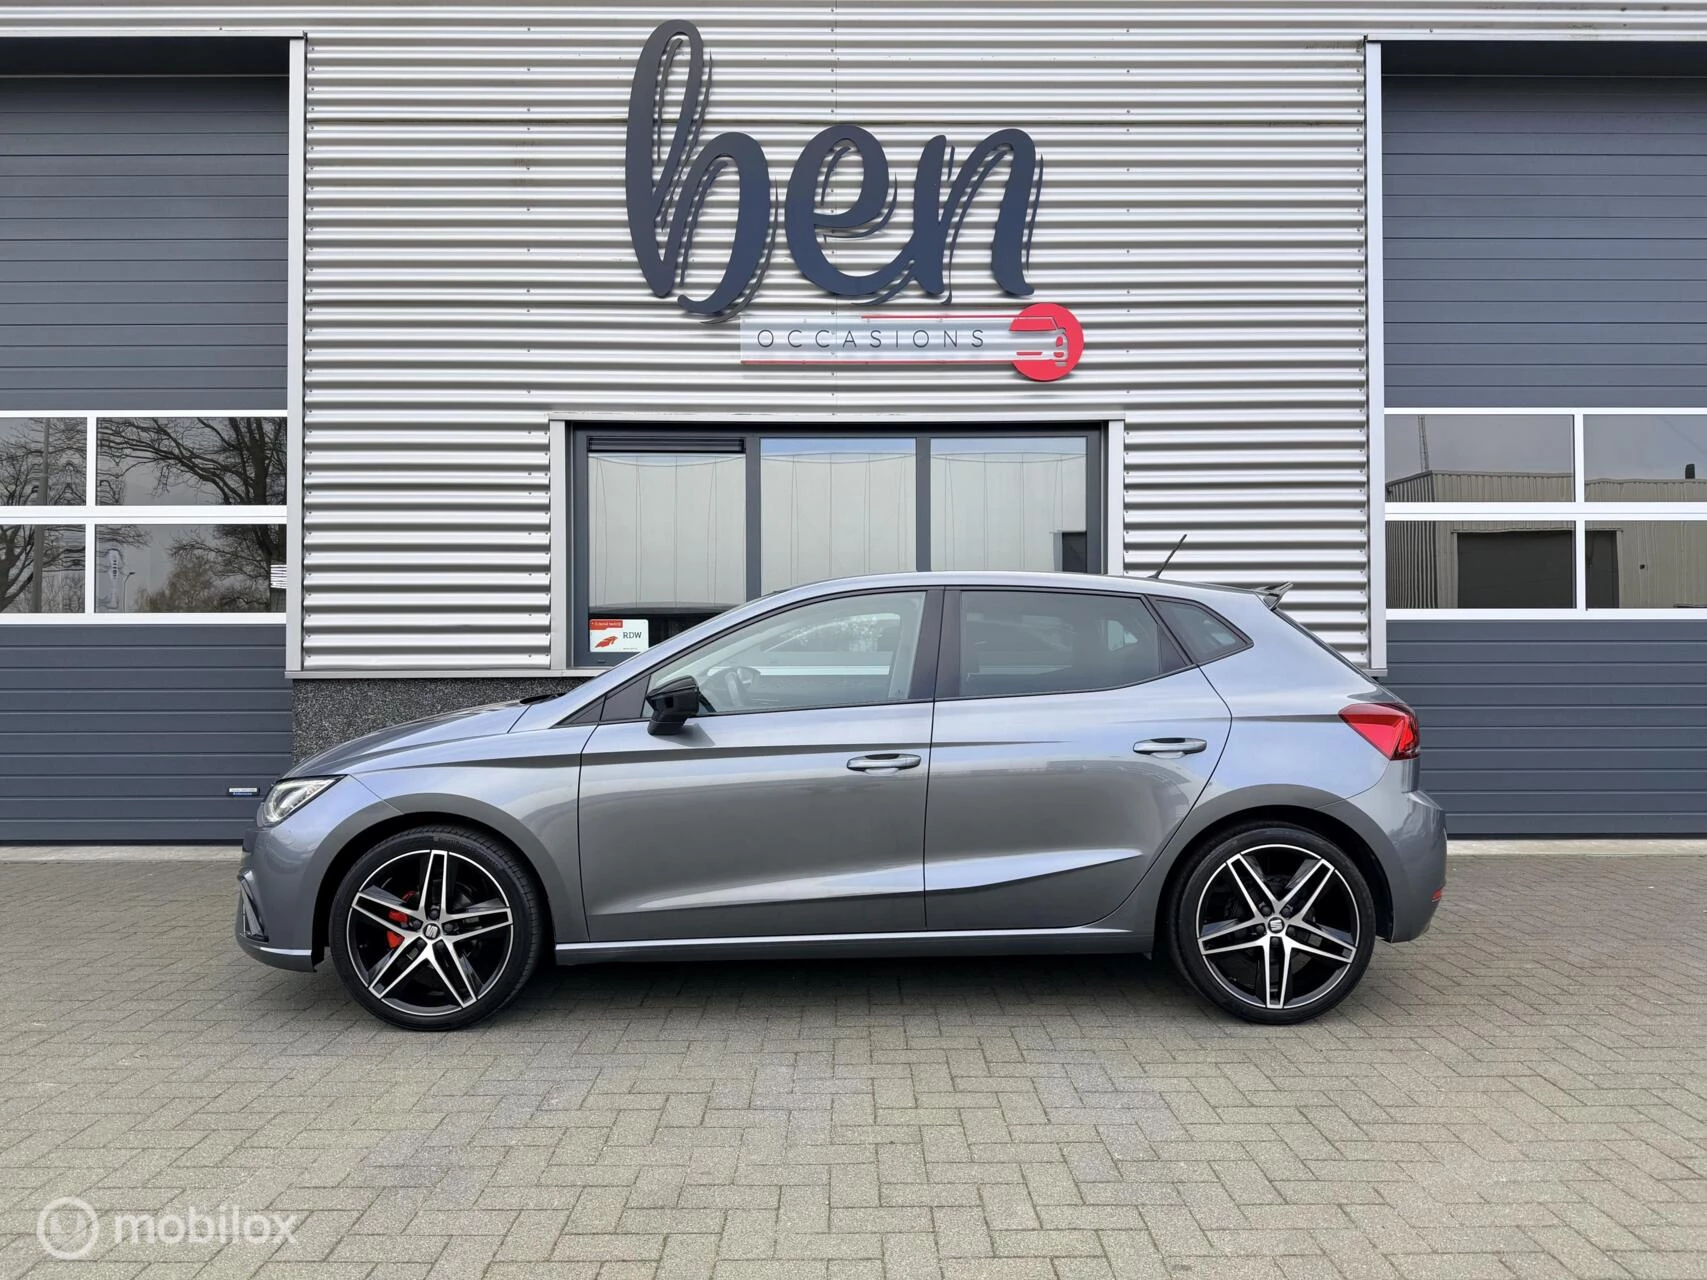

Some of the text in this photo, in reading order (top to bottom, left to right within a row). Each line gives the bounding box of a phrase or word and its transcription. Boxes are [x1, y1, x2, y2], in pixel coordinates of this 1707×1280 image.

[625, 19, 1041, 320] ben
[756, 328, 985, 349] OCCASIONS
[622, 631, 642, 639] RDW
